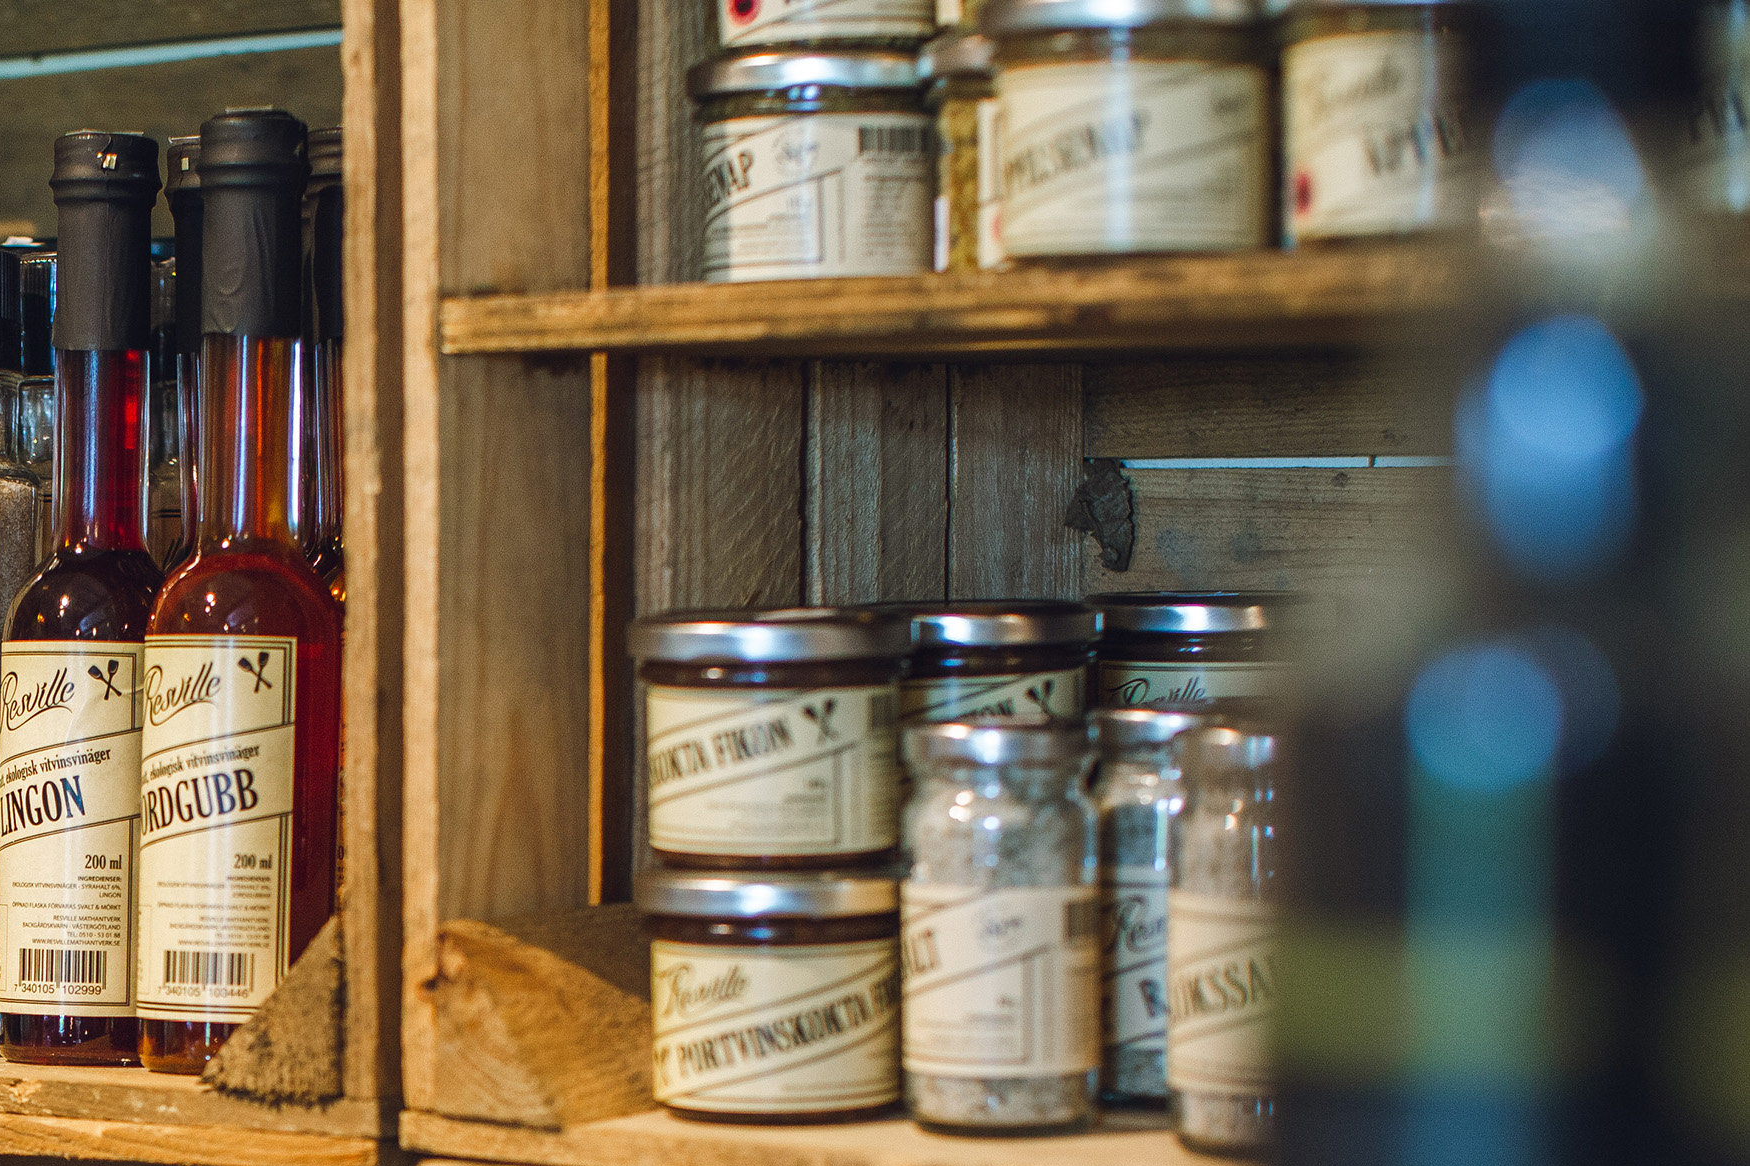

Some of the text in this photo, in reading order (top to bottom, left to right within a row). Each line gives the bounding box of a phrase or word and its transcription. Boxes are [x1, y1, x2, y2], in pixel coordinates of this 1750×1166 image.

[0, 667, 75, 731] Resville
[144, 661, 221, 727] Resville
[5, 748, 111, 785] ekologisk vitvinsvinäger
[0, 774, 86, 837] LINGON
[85, 854, 122, 870] 200 ml
[234, 853, 272, 869] 200 ml
[21, 983, 102, 995] 340105 102999
